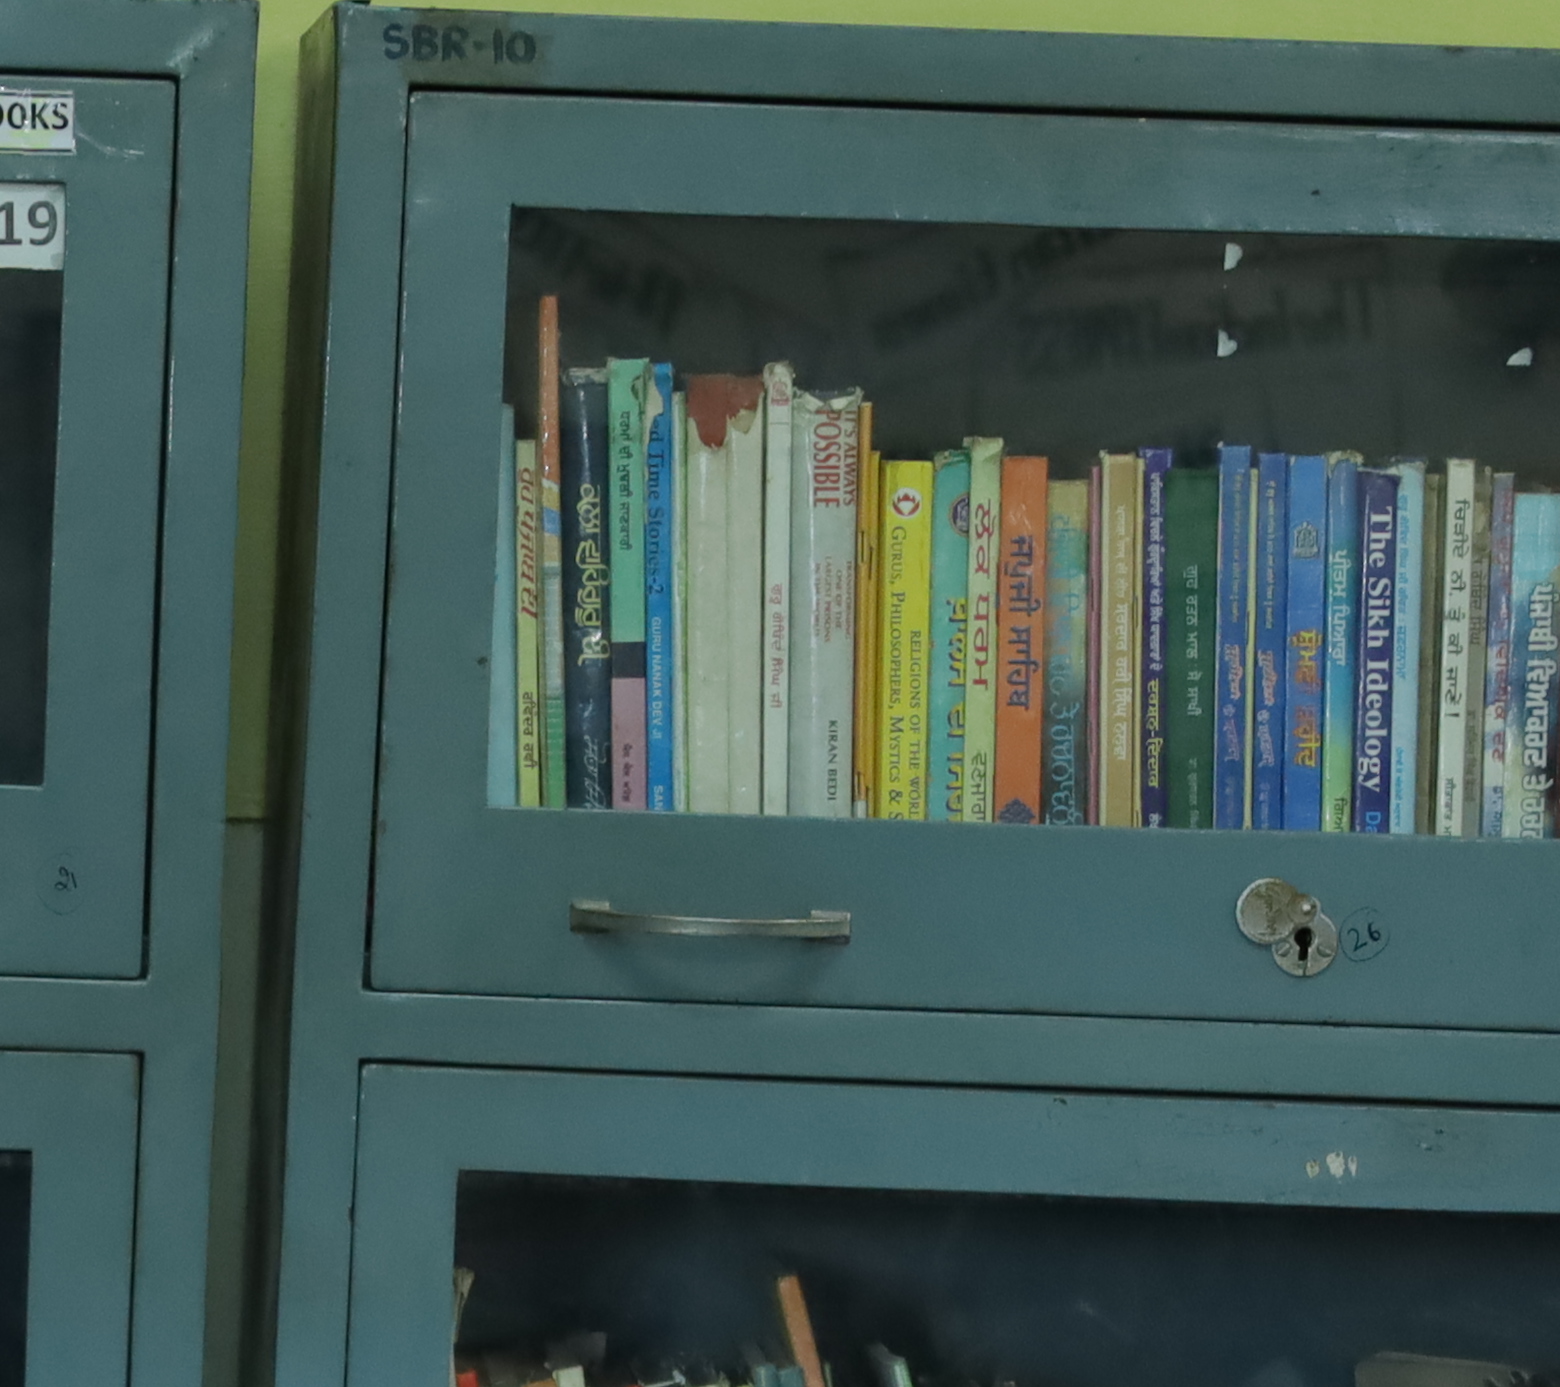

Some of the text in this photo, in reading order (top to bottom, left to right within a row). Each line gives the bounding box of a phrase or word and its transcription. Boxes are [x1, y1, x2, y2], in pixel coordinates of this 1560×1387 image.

[647, 452, 666, 595] Time Stories-2
[813, 407, 840, 507] POSSIBLE
[843, 410, 858, 506] IT'S ALWAYS
[972, 499, 996, 691] ਲੋਕ ਧਰਮ
[1004, 535, 1040, 711] ਜਪੁਜੀ ਸਾਹਿਬ
[1359, 506, 1393, 792] The Sikh Ideology
